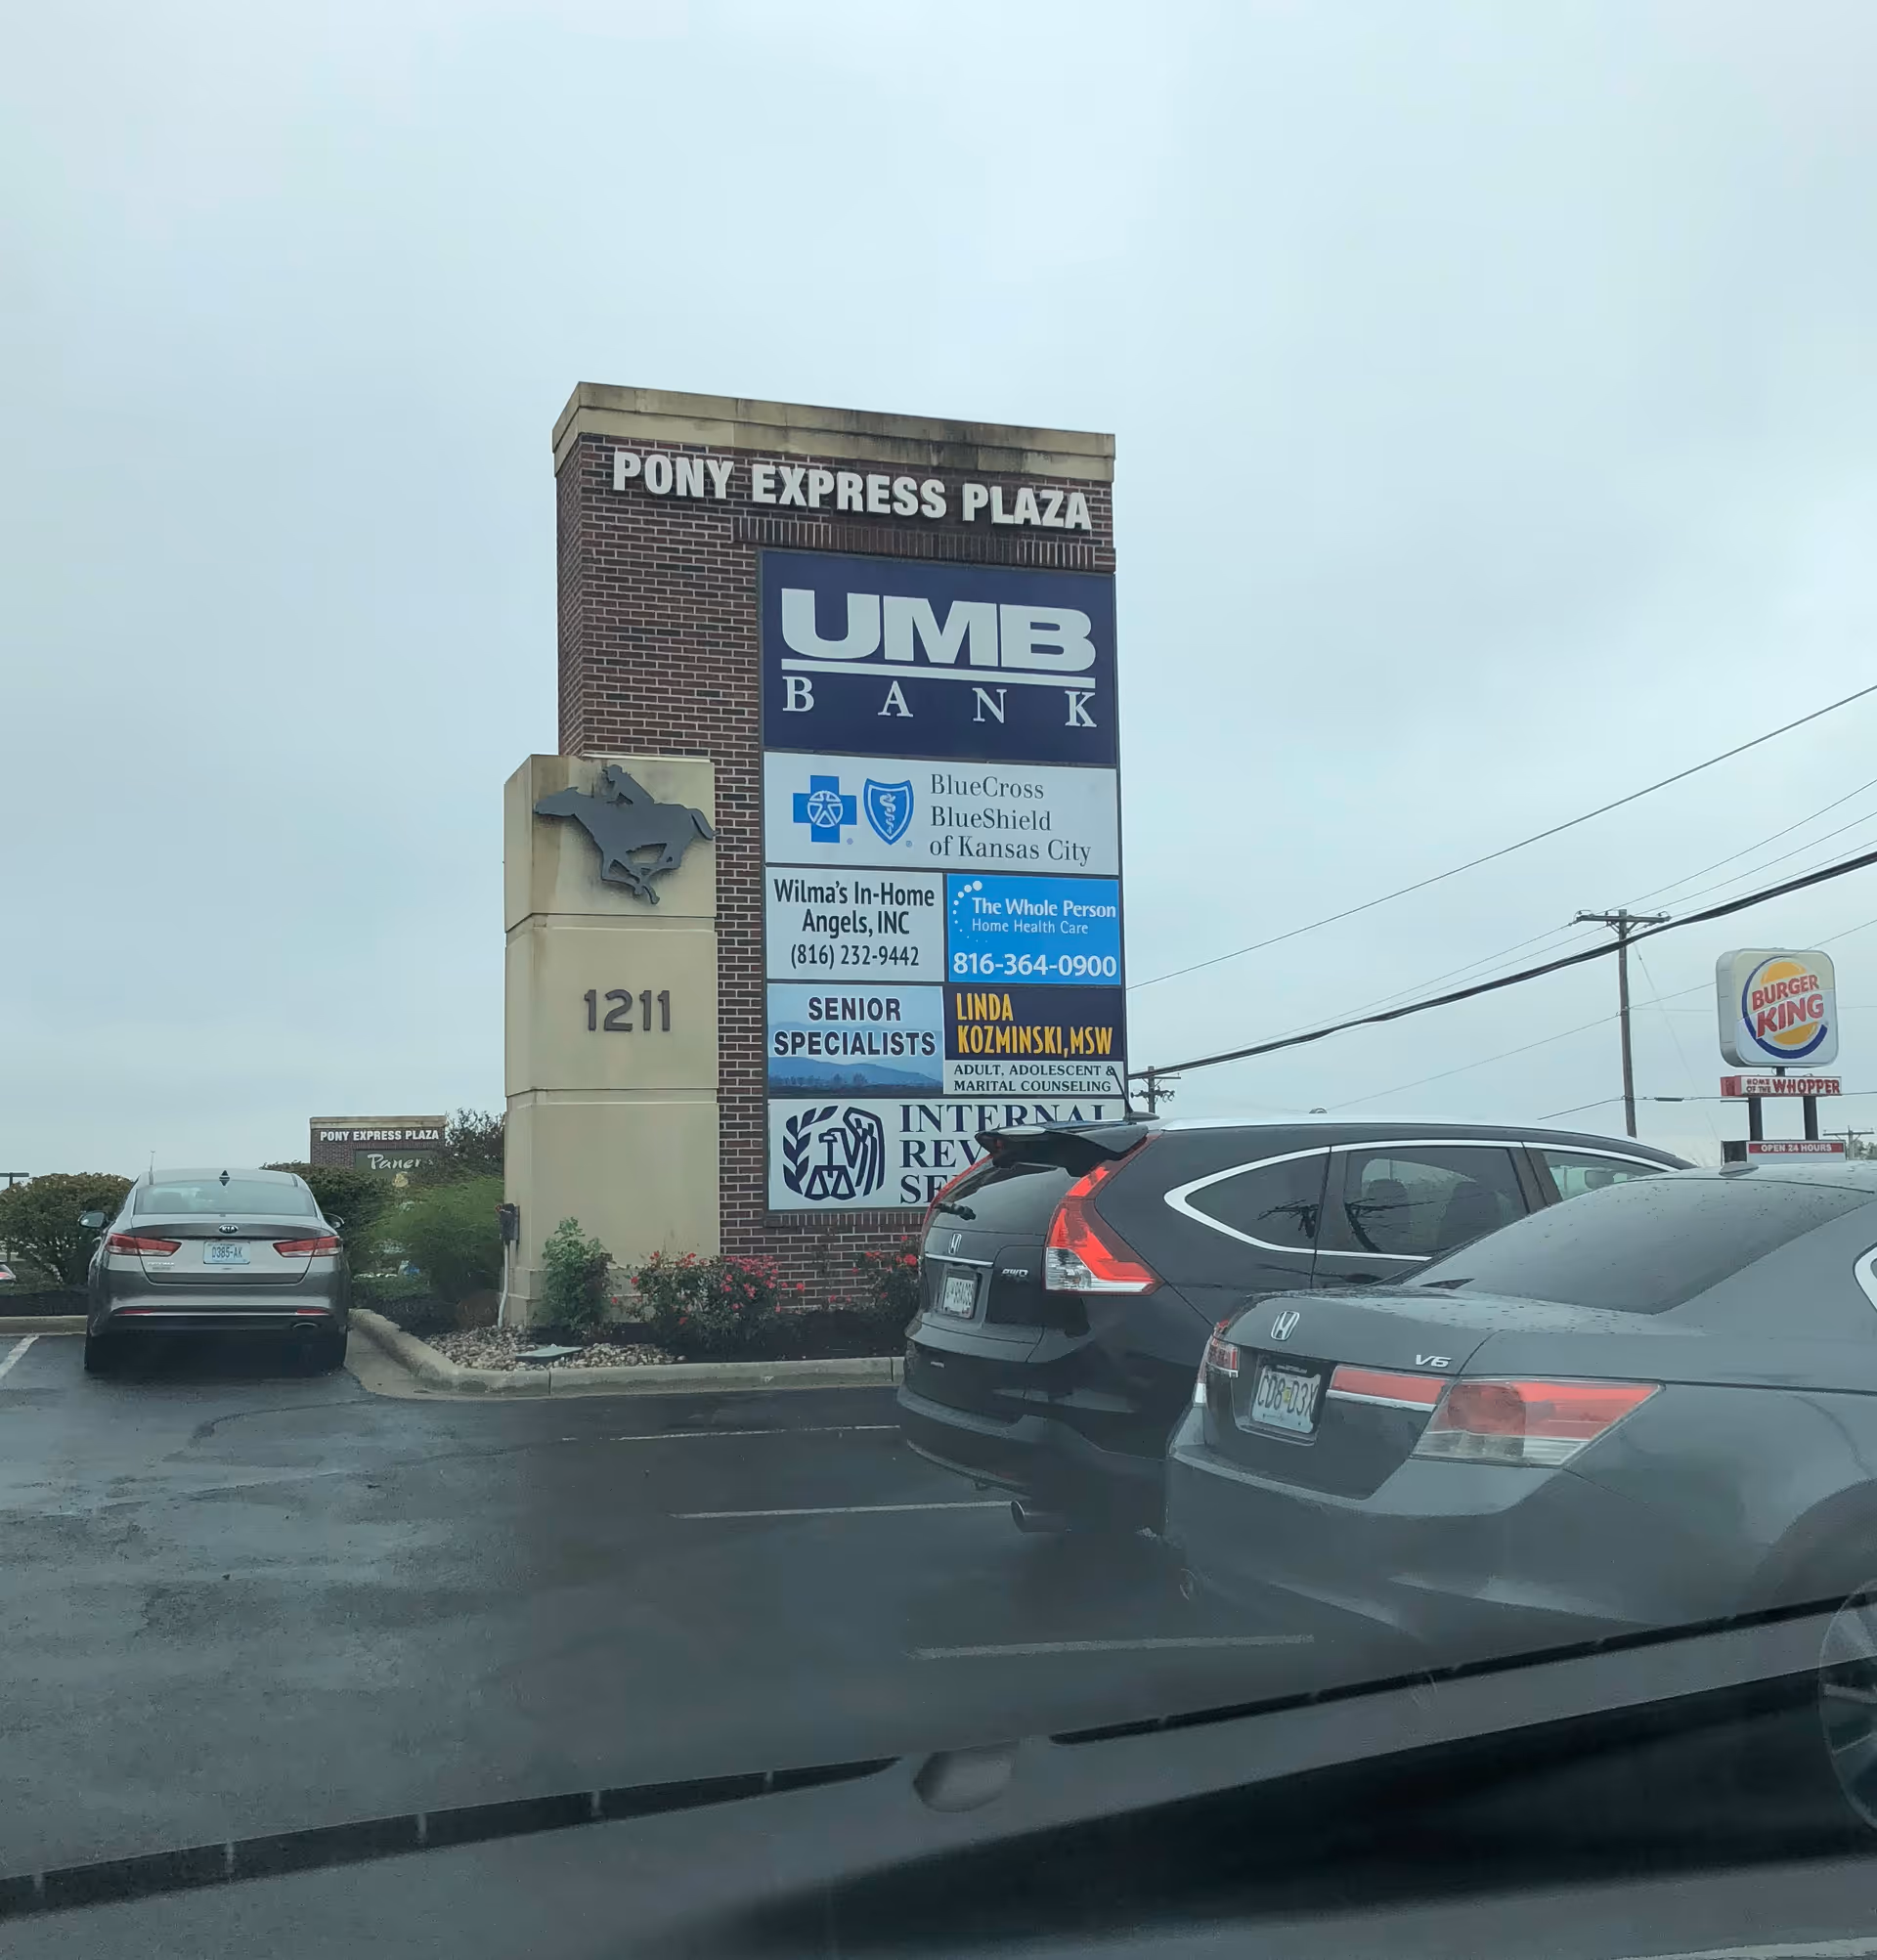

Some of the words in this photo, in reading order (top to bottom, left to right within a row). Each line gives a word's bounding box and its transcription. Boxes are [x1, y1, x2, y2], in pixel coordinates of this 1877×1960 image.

[613, 451, 734, 500] PONY
[752, 463, 947, 519] EXPRESS
[962, 482, 1092, 531] PLAZA
[781, 588, 1097, 673] UMB
[782, 675, 1098, 728] BANK
[931, 773, 1044, 800] BlueCross
[931, 806, 1051, 832] BlueShield
[930, 835, 954, 857] of
[958, 836, 1040, 861] Kansas
[1047, 839, 1092, 867] City
[773, 879, 849, 905] Wilma's
[854, 881, 935, 907] In-Home
[972, 897, 1002, 915] The
[1005, 898, 1058, 917] Whole
[1063, 900, 1116, 918] Person
[802, 909, 873, 939] Angels,
[878, 911, 910, 936] INC
[972, 918, 1009, 933] Home
[1014, 919, 1056, 934] Health
[1060, 921, 1089, 935] Care
[790, 943, 835, 970] (816)
[841, 944, 920, 967] 232-9442
[953, 951, 1117, 978] 816-364-0900
[1751, 974, 1820, 1012] BURGER
[584, 988, 671, 1031] 1211
[808, 996, 901, 1022] SENIOR
[956, 992, 1014, 1022] LINDA
[1756, 993, 1825, 1038] KING
[773, 1030, 937, 1057] SPECIALISTS
[954, 1064, 1004, 1076] ADULT,
[1009, 1065, 1102, 1076] ADOLESCENT
[954, 1080, 1017, 1092] MARITAL
[1021, 1080, 1112, 1092] COUNSELING
[1771, 1078, 1840, 1094] WHOPPER
[320, 1130, 350, 1142] PONY
[353, 1130, 402, 1141] EXPRESS
[405, 1129, 440, 1140] PLAZA
[1761, 1144, 1786, 1153] OPEN
[1801, 1144, 1833, 1153] HOURS
[367, 1154, 433, 1170] Paner
[1416, 1354, 1452, 1368] V6
